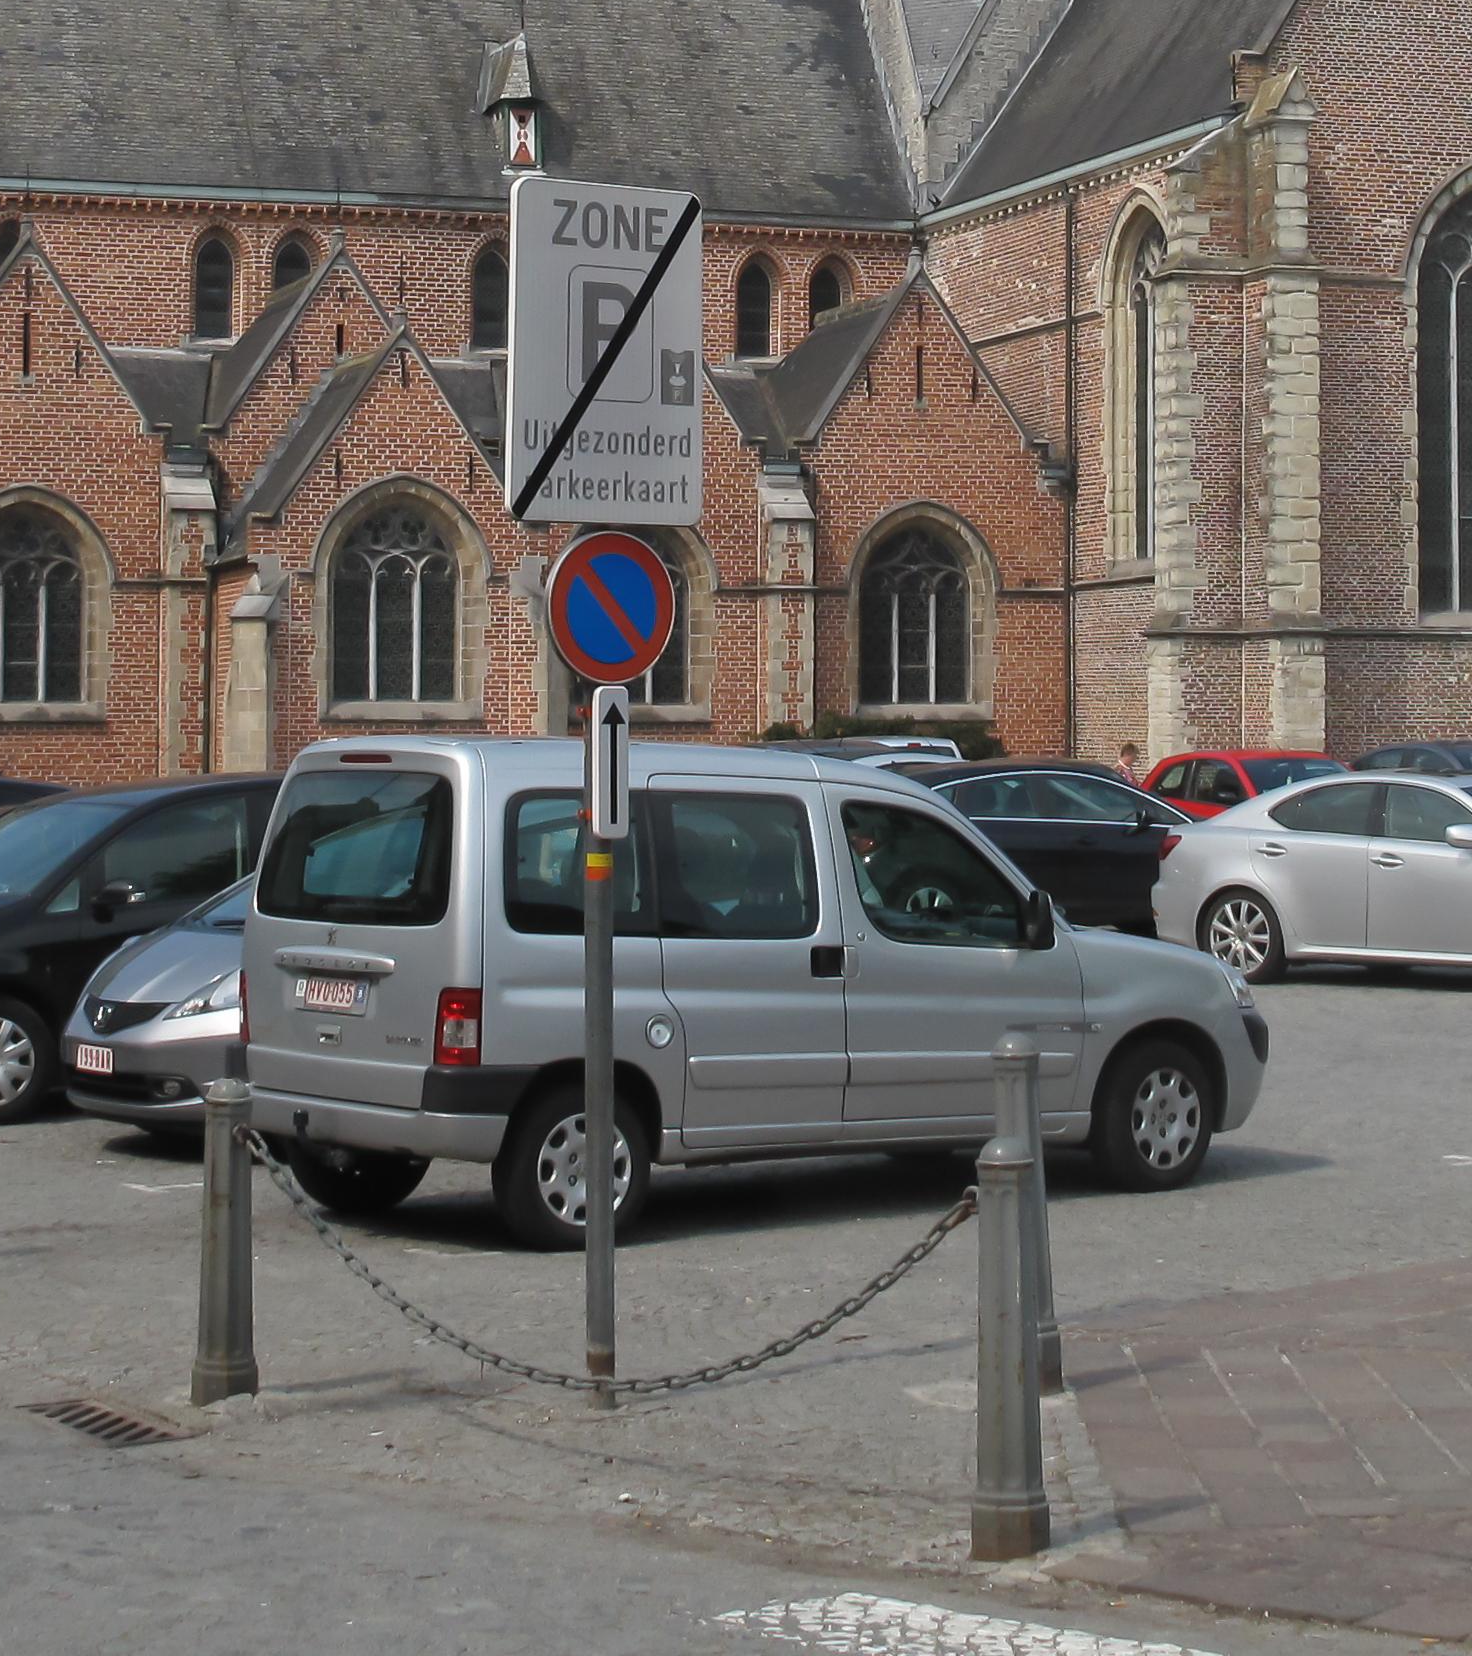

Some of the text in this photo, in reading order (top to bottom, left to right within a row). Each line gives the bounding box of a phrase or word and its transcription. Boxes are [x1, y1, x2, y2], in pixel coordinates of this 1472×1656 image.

[552, 199, 668, 253] ZONE
[581, 281, 639, 384] P
[525, 469, 689, 504] arkeerkaart
